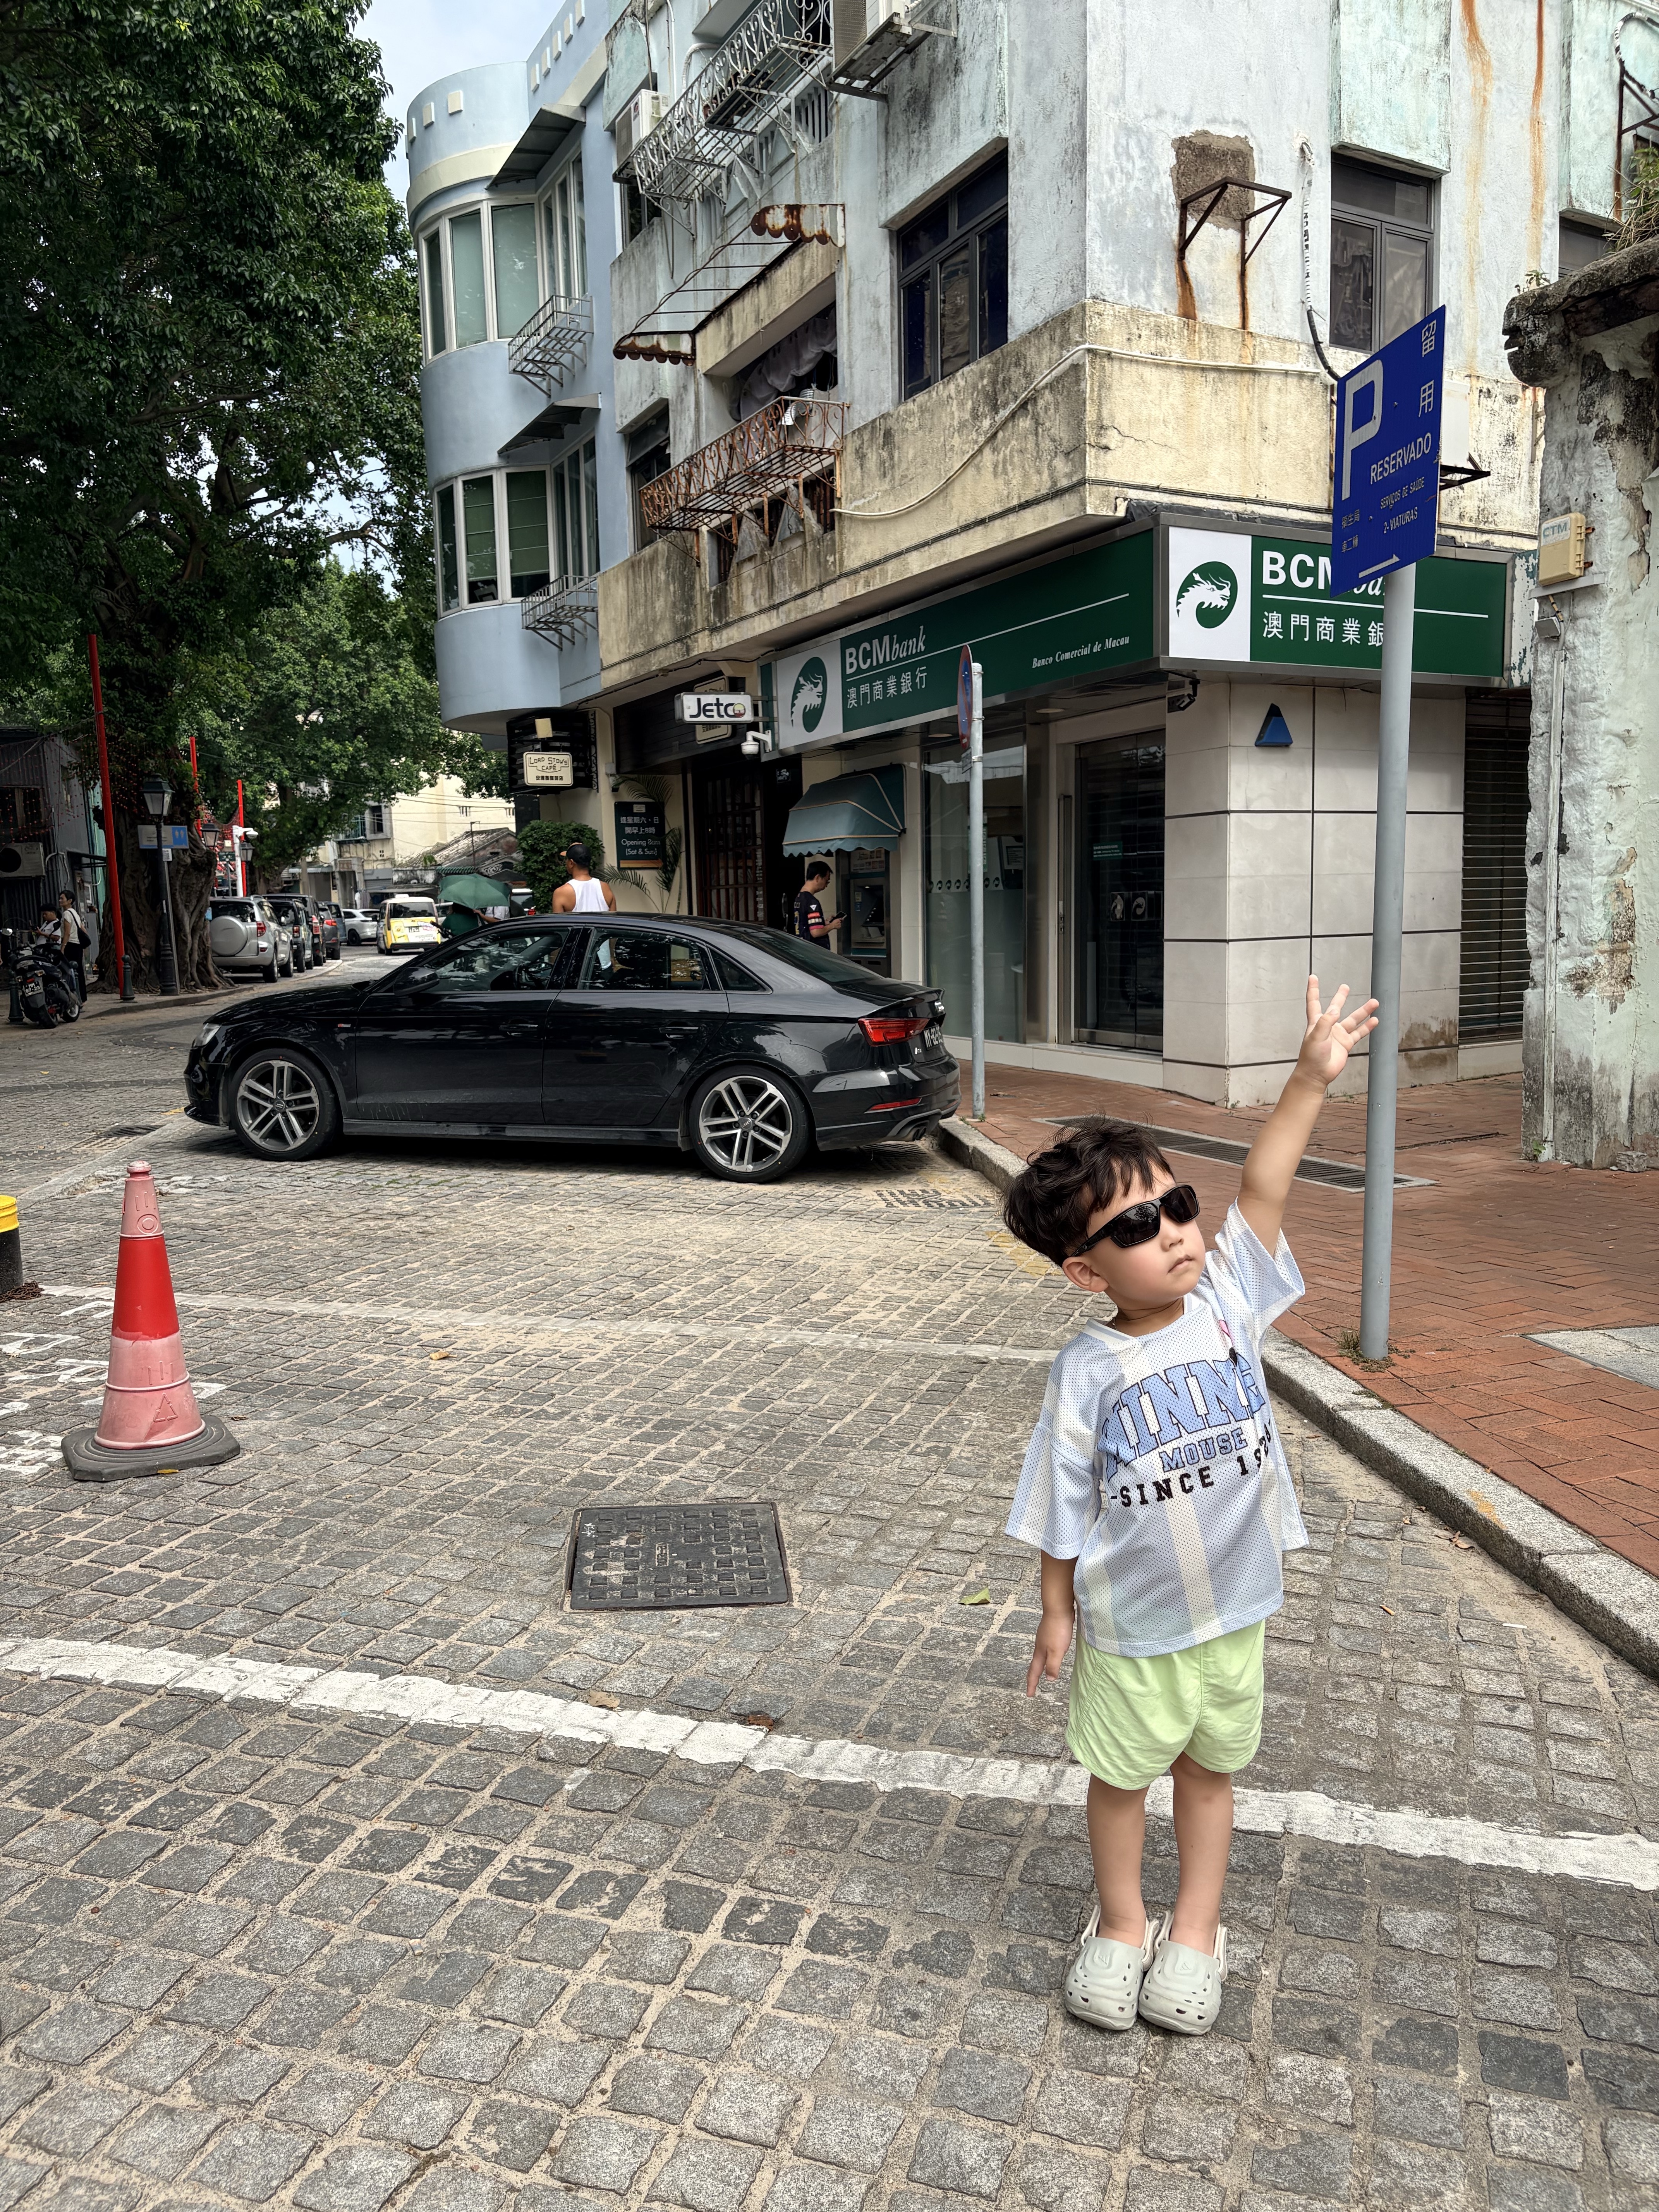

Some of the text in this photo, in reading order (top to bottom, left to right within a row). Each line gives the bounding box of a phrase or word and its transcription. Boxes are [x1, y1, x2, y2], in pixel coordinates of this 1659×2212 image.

[1342, 360, 1383, 500] P
[1370, 432, 1431, 484] RESERVADO
[1402, 485, 1408, 498] DE
[1543, 522, 1567, 539] CTM
[1263, 611, 1384, 647] 澳門商業銀
[845, 625, 926, 675] BCMbank
[1032, 636, 1129, 668] Banco Comercial de Macau
[847, 666, 927, 709] 澳門商業銀行
[621, 839, 646, 847] Opening
[1159, 1427, 1248, 1472] MOUSE
